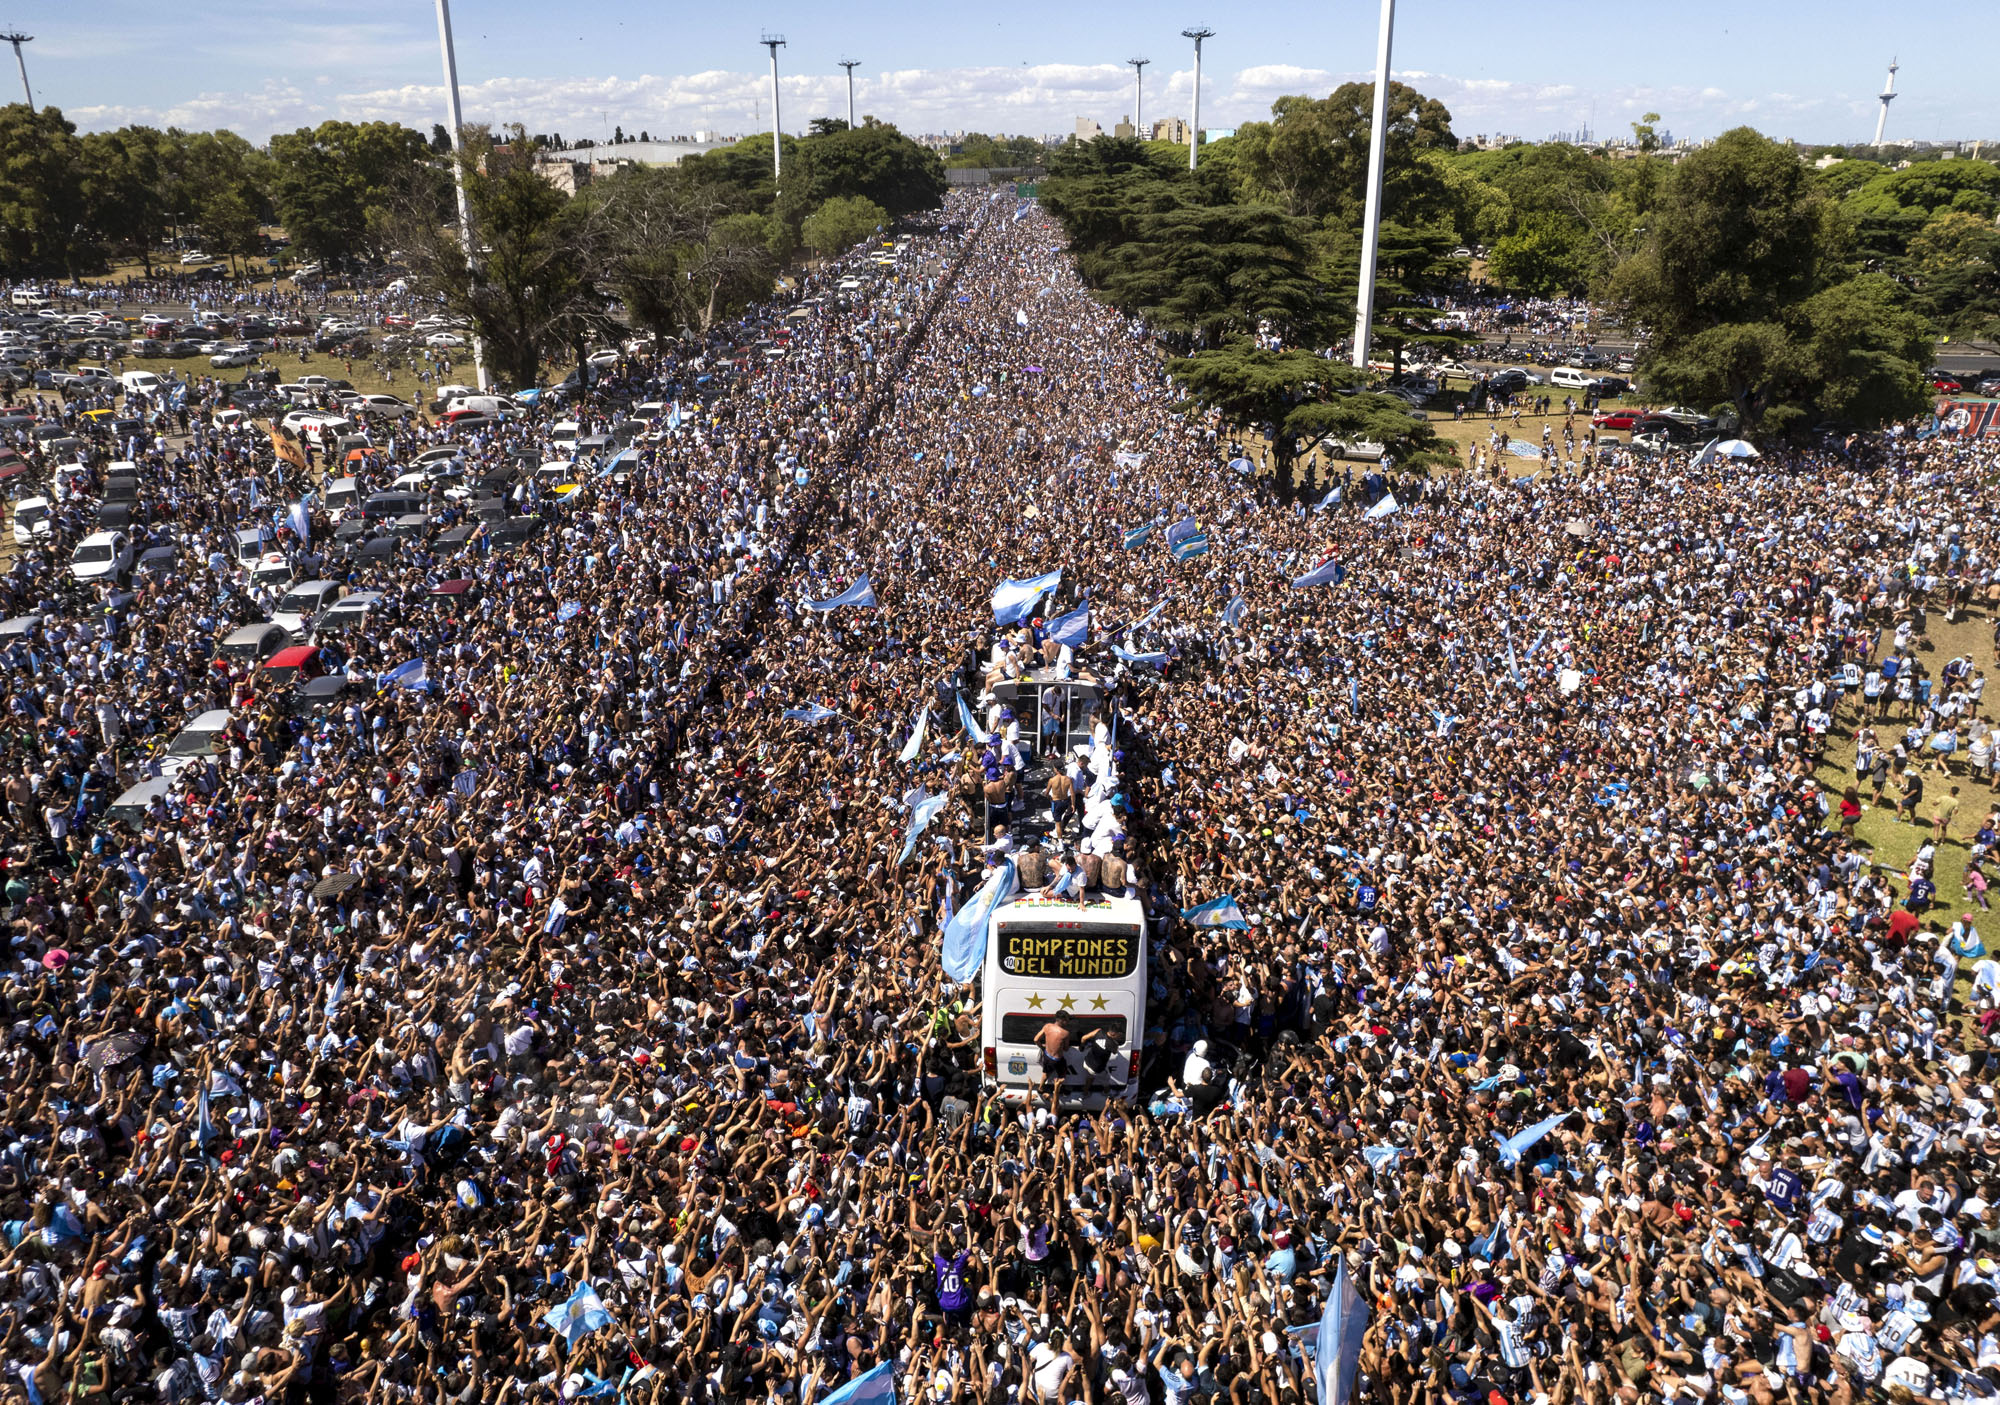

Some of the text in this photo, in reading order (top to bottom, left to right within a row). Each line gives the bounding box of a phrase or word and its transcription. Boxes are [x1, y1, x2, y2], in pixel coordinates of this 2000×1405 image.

[1844, 668, 1856, 678] 10
[1917, 889, 1925, 899] 9
[1009, 937, 1128, 957] CAMPEONES
[1014, 957, 1127, 975] DEL MUNDO
[1770, 1178, 1787, 1198] 10
[1814, 1220, 1830, 1235] 10
[941, 1274, 960, 1293] 10
[1837, 1295, 1852, 1311] 10
[1885, 1325, 1901, 1343] 10
